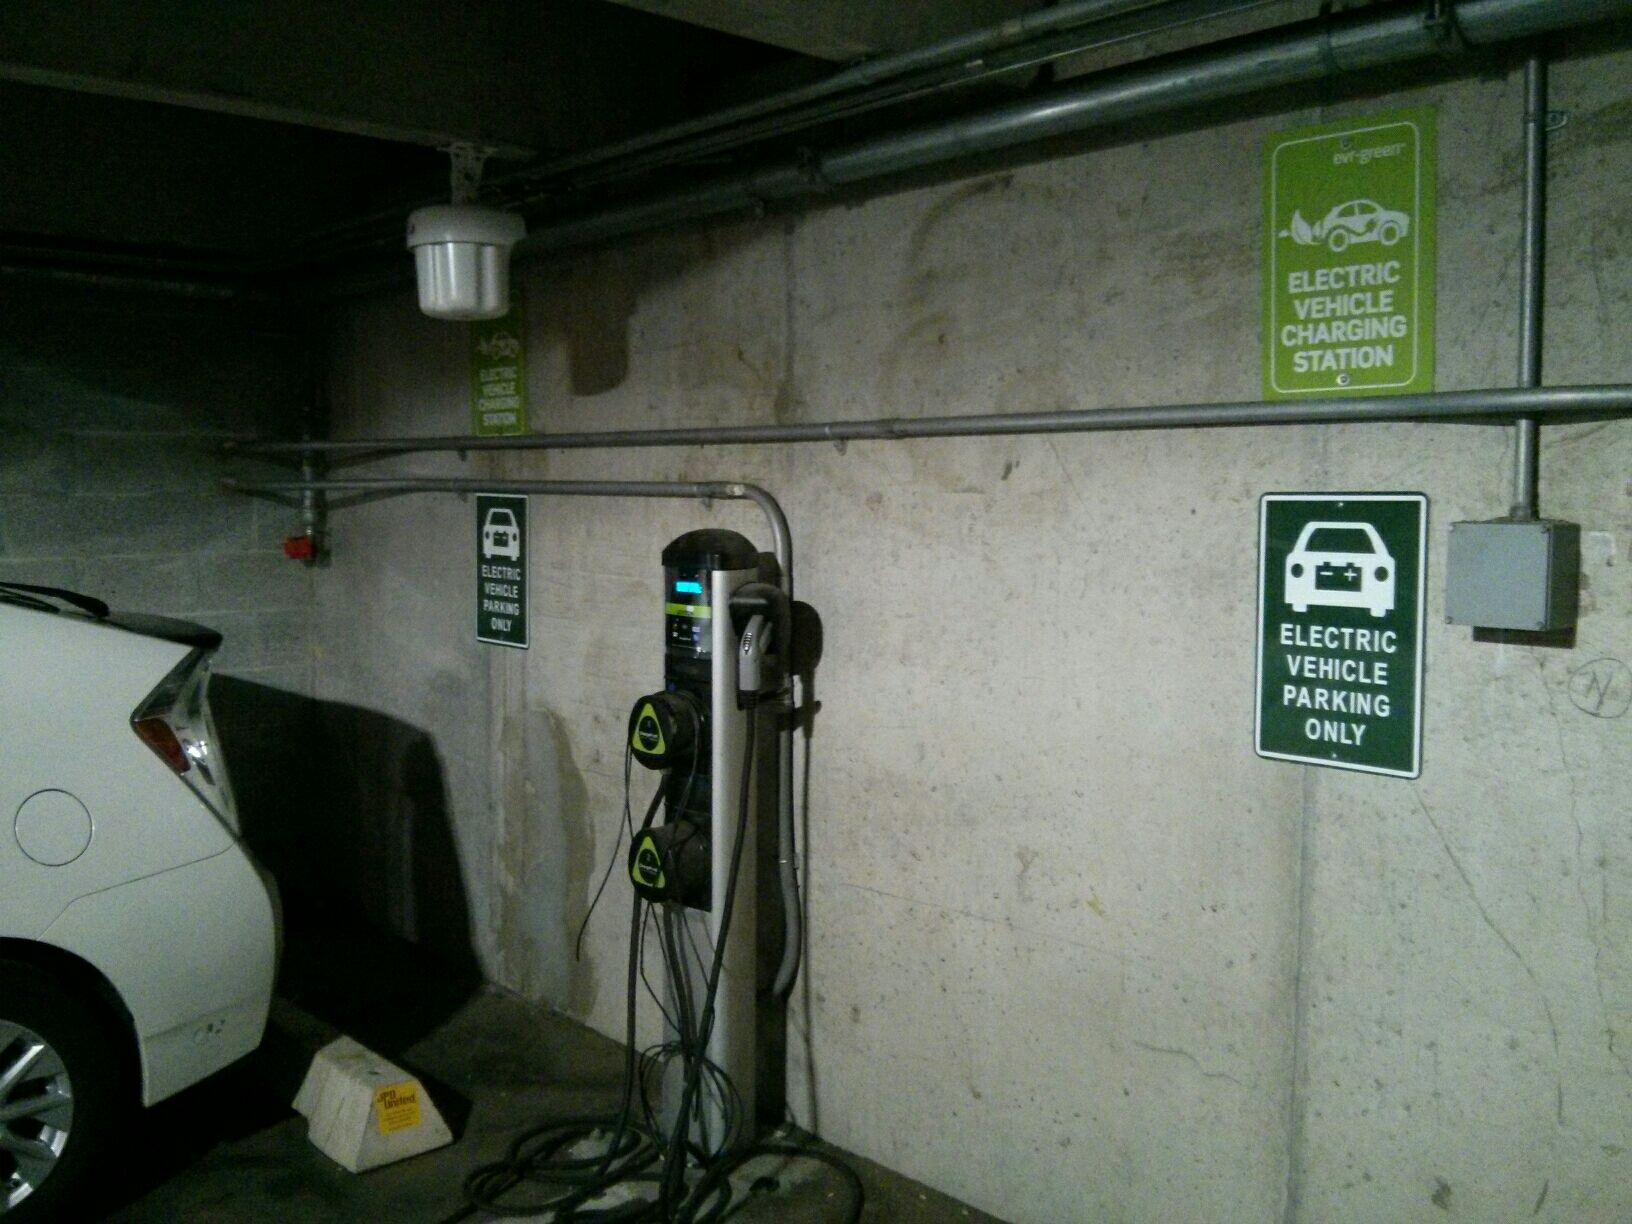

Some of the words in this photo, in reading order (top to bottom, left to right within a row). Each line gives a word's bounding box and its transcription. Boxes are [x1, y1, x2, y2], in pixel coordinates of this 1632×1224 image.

[1288, 261, 1400, 293] ELECTRIC
[1294, 290, 1395, 320] VEHICLE
[1281, 316, 1407, 346] CHARGING
[1293, 344, 1395, 373] STATION
[483, 412, 517, 426] STATION
[481, 564, 521, 581] ELECTRIC
[484, 582, 518, 598] VEHICLE
[483, 599, 520, 616] PARKING
[491, 617, 512, 632] ONLY
[1280, 623, 1398, 654] ELECTRIC
[1286, 655, 1389, 685] VEHICLE
[1282, 685, 1391, 717] PARKING
[1304, 718, 1367, 746] ONLY
